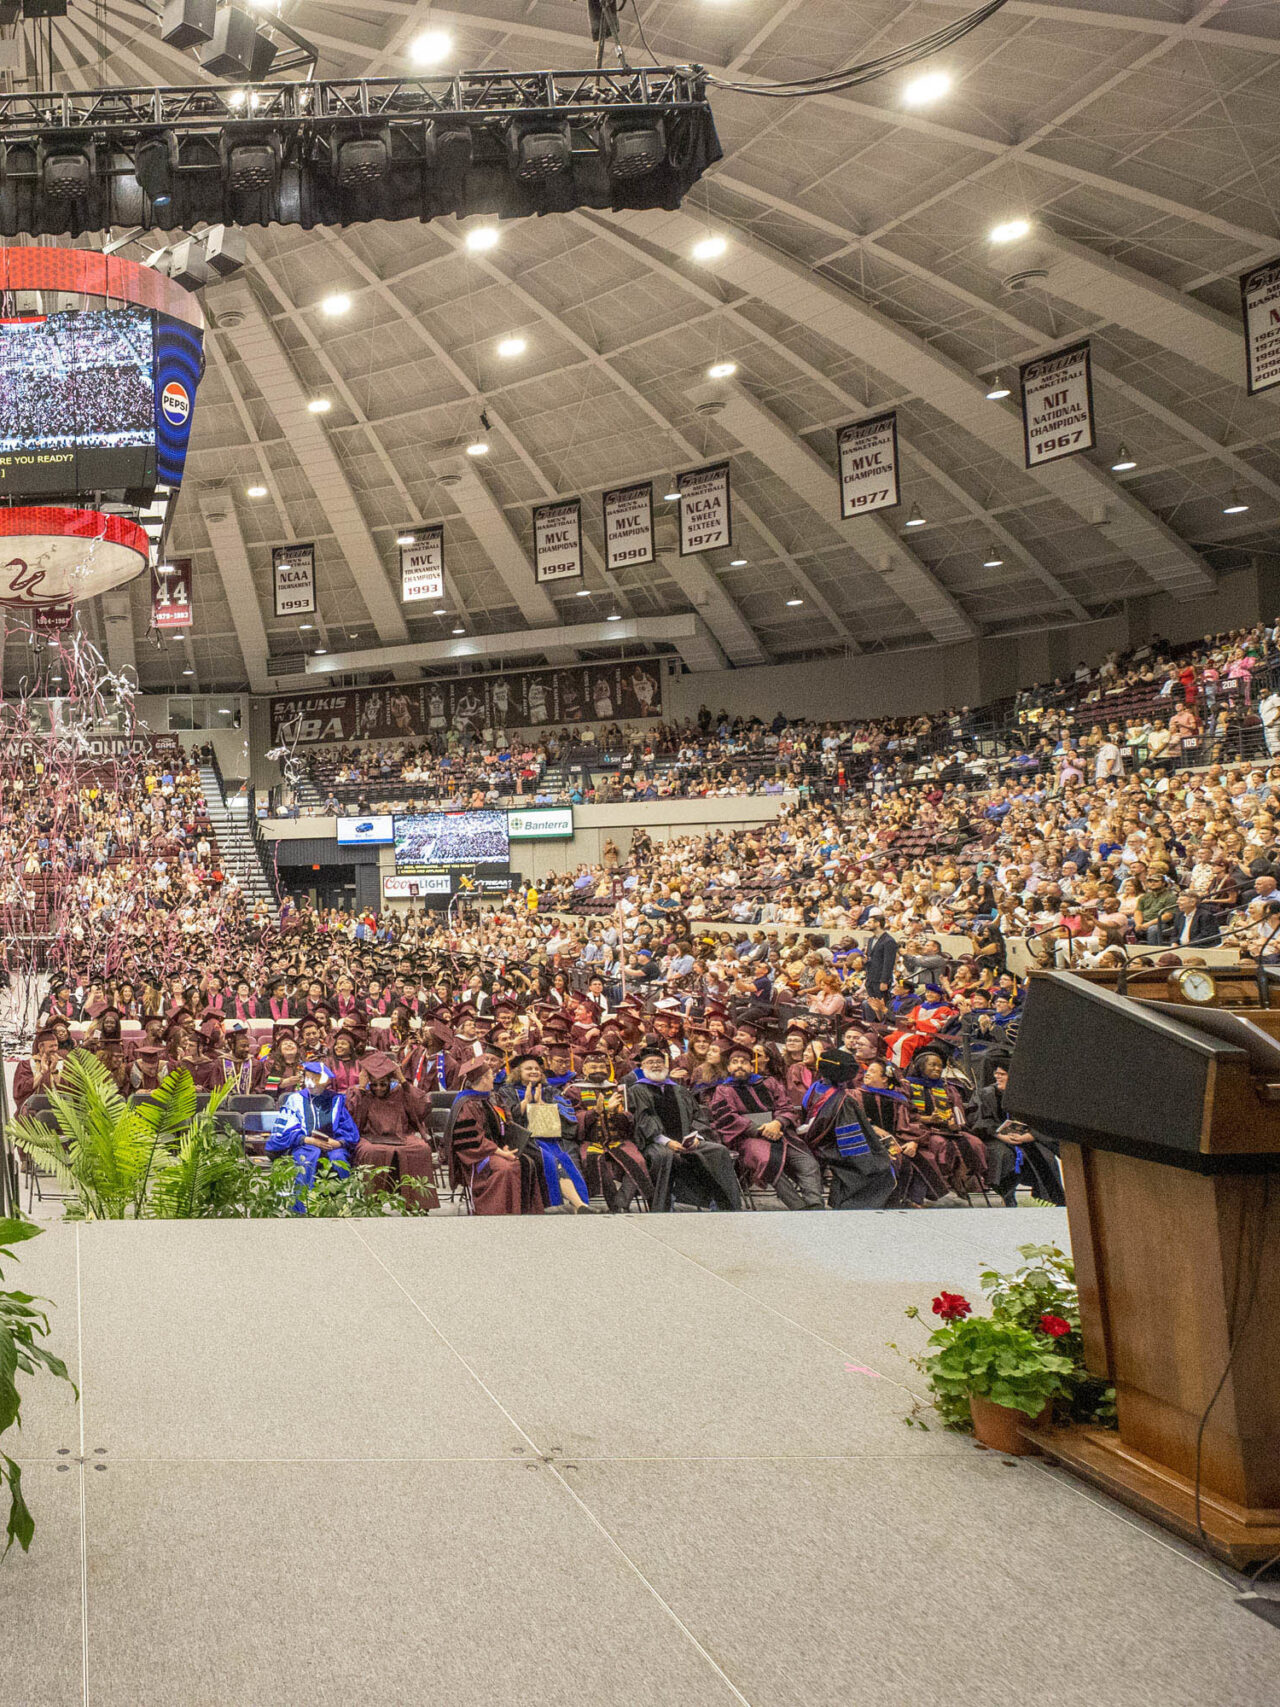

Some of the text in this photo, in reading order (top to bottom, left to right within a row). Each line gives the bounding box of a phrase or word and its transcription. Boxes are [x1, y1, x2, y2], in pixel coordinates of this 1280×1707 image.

[1027, 371, 1084, 395] BASKETBALL
[164, 395, 188, 412] PEPSI
[1043, 389, 1069, 410] NIT
[1033, 402, 1083, 426] NATIONAL
[1030, 411, 1087, 438] CHAMPIONS
[842, 437, 891, 455] BASKETBALL
[1035, 430, 1083, 455] 1967
[14, 455, 35, 464] YOU
[37, 454, 74, 463] READY?
[852, 452, 882, 471] MVC
[844, 463, 893, 484] CHAMPIONS
[686, 496, 721, 515] NCAA
[850, 489, 889, 508] 1977
[615, 515, 641, 530] MVC
[691, 511, 717, 523] SWEET
[608, 526, 649, 541] CHAMPIONS
[688, 519, 721, 533] SIXTEEN
[545, 530, 569, 545] MVC
[688, 531, 722, 547] 1977
[538, 541, 578, 555] CHAMPIONS
[612, 547, 647, 562] 1990
[410, 555, 433, 567] MVC
[542, 562, 575, 575] 1992
[280, 570, 308, 583] NCAA
[404, 565, 440, 575] TOURNAMENT
[156, 581, 187, 606] 44
[408, 584, 438, 595] 1993
[281, 599, 309, 610] 1993
[273, 696, 347, 715] SALUKIS
[275, 717, 345, 743] NBA
[524, 821, 568, 830] Banterra
[419, 879, 449, 889] LIGHT
